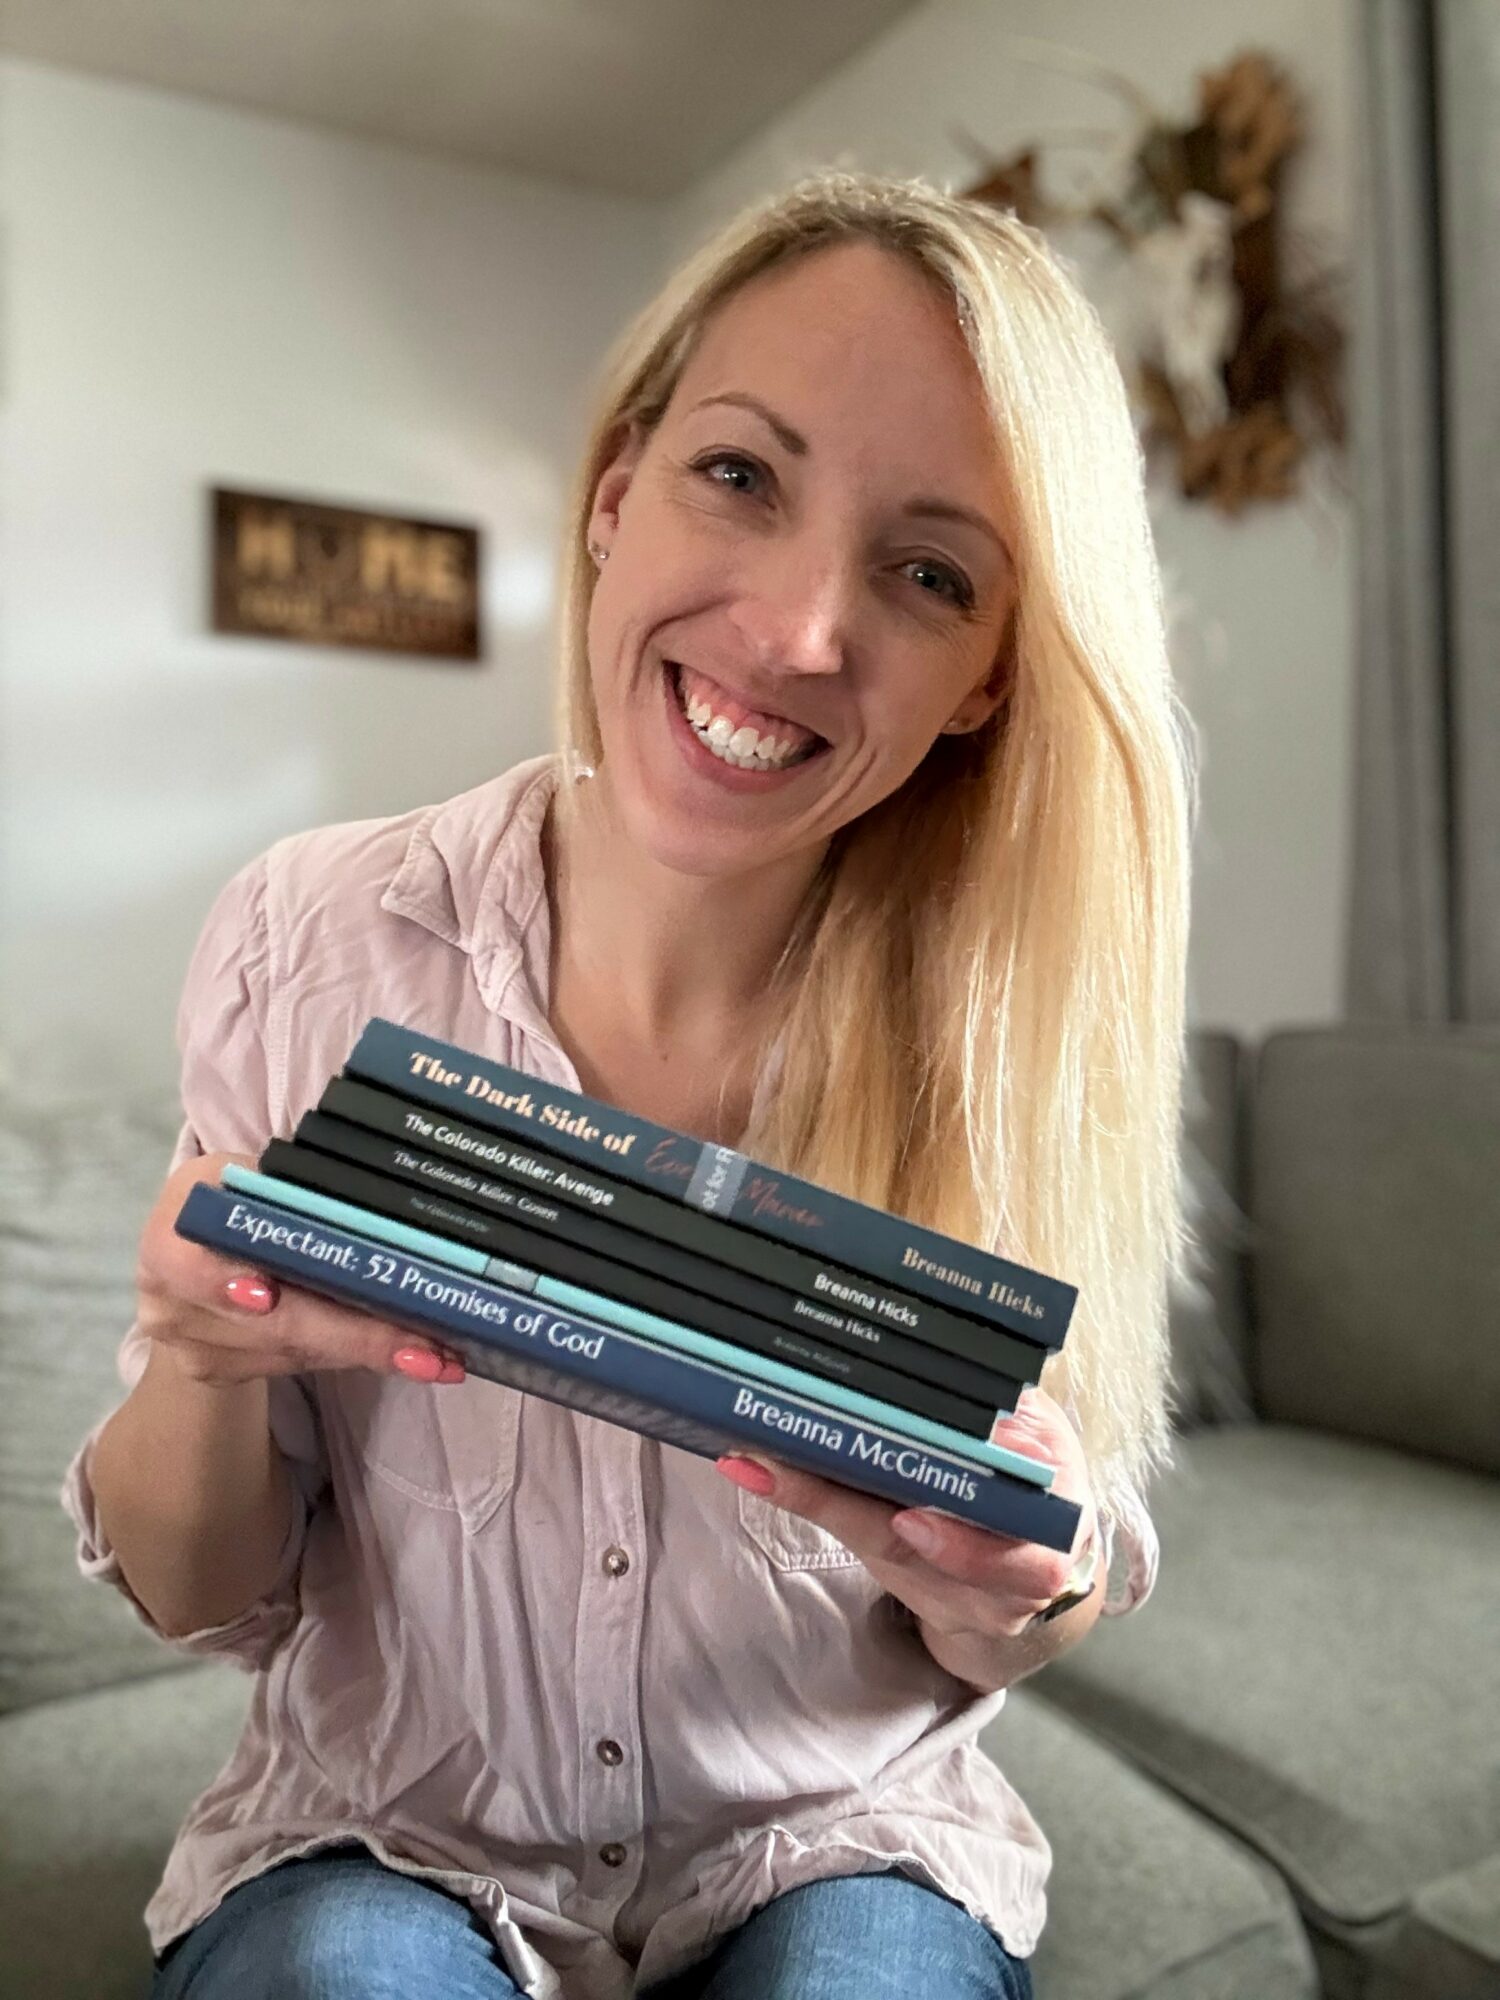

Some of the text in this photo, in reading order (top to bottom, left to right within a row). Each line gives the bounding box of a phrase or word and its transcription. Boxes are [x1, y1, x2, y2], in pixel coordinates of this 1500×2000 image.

[408, 1052, 462, 1088] The
[465, 1075, 535, 1119] Dark
[538, 1102, 601, 1142] Side
[602, 1133, 637, 1157] of
[394, 1150, 420, 1171] The
[419, 1161, 478, 1191] Colorado
[405, 1113, 615, 1208] The Colorado Killer: Avenge
[225, 1203, 606, 1361] Expectant: 52 Promises of God
[793, 1299, 880, 1344] Breanna Hicks
[814, 1273, 919, 1328] Breanna Hicks
[901, 1247, 1045, 1321] Breanna Hicks
[732, 1387, 980, 1502] Breanna McGinnis
